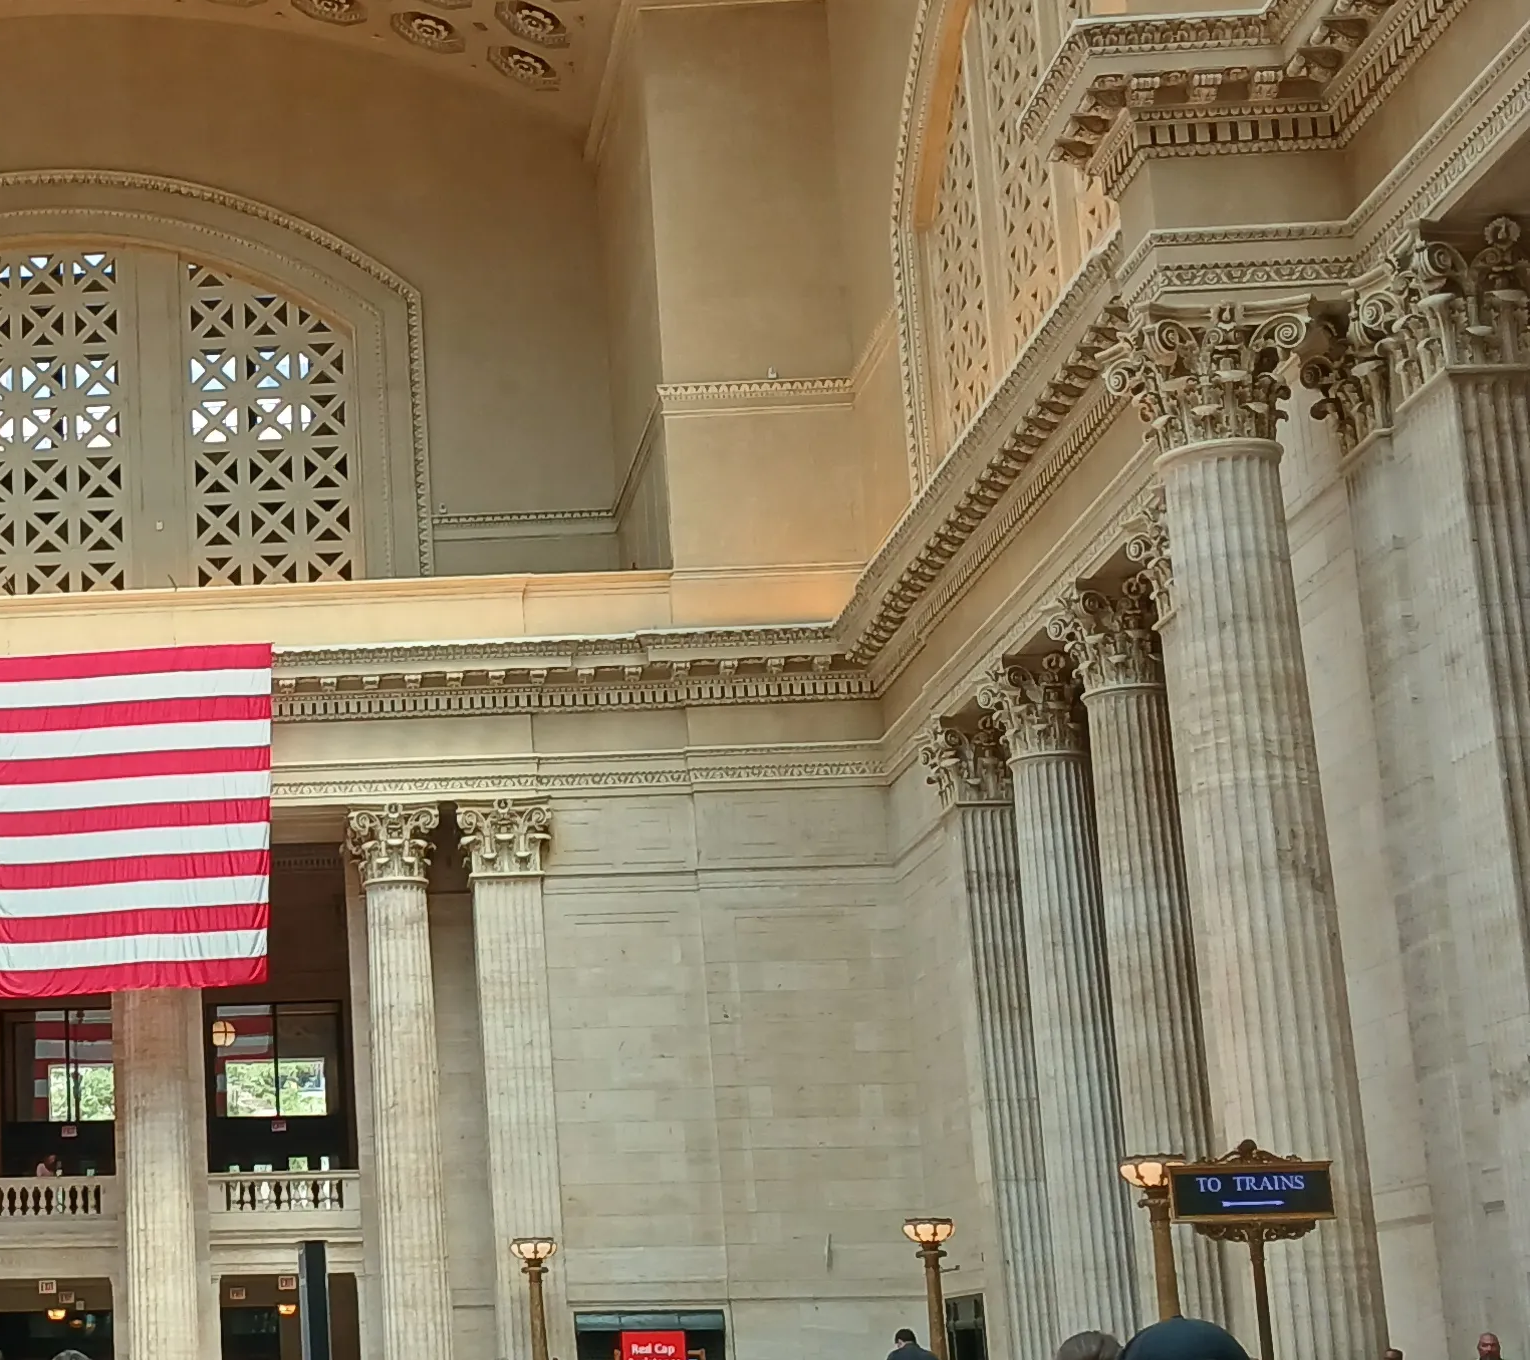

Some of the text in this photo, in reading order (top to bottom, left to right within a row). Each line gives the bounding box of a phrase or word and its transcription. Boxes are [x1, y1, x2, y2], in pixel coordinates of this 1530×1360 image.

[1195, 1174, 1306, 1193] TO TRAINS
[631, 1342, 676, 1356] Red Cap
